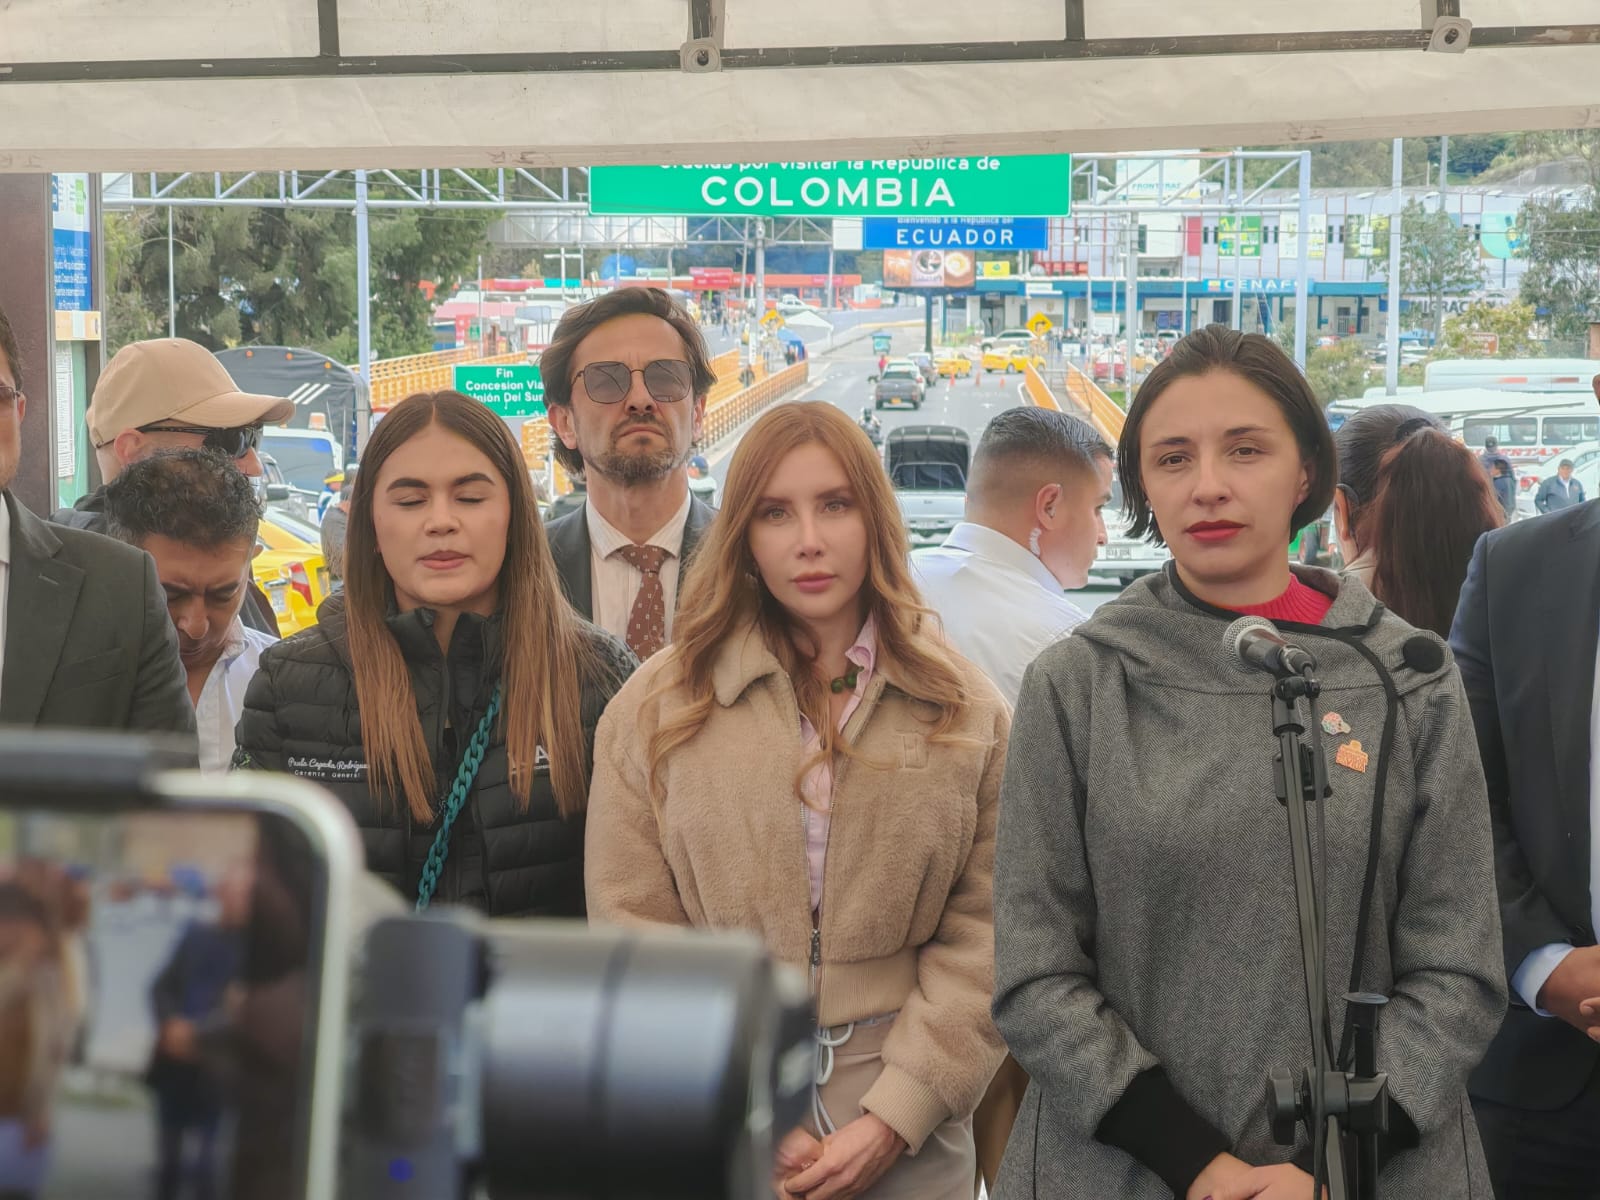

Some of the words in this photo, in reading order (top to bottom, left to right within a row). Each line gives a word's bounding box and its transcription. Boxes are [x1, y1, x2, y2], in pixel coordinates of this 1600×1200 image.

[976, 156, 1001, 170] de
[701, 176, 956, 208] COLOMBIA
[896, 228, 1014, 245] ECUADOR
[496, 368, 513, 378] Fin
[465, 380, 524, 391] Concesion
[503, 391, 522, 402] Del
[524, 391, 544, 401] Sur
[288, 757, 309, 768] Paula
[294, 769, 326, 777] Gerente
